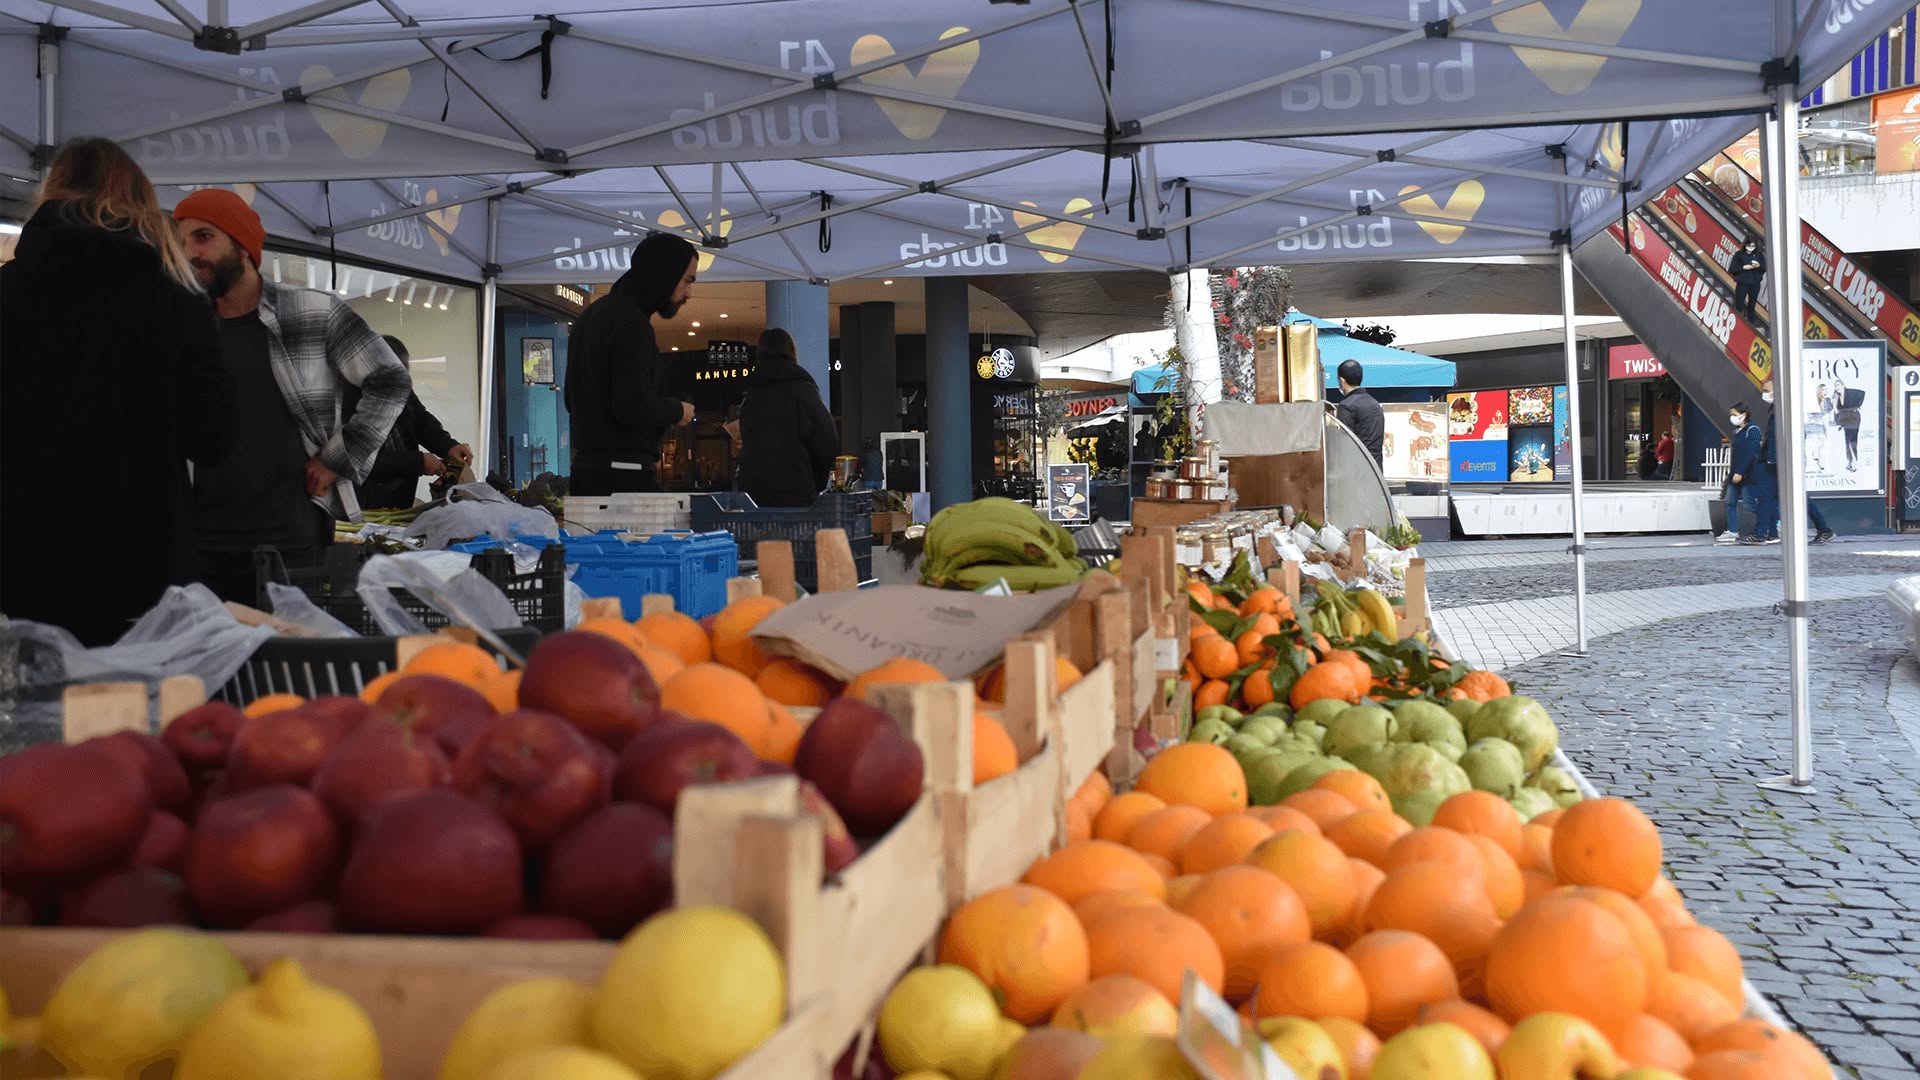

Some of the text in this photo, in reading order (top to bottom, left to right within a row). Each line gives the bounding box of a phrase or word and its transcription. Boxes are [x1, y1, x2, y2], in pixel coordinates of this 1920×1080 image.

[1901, 318, 1918, 344] 26
[1750, 341, 1765, 368] 26
[695, 368, 737, 381] KAHVE
